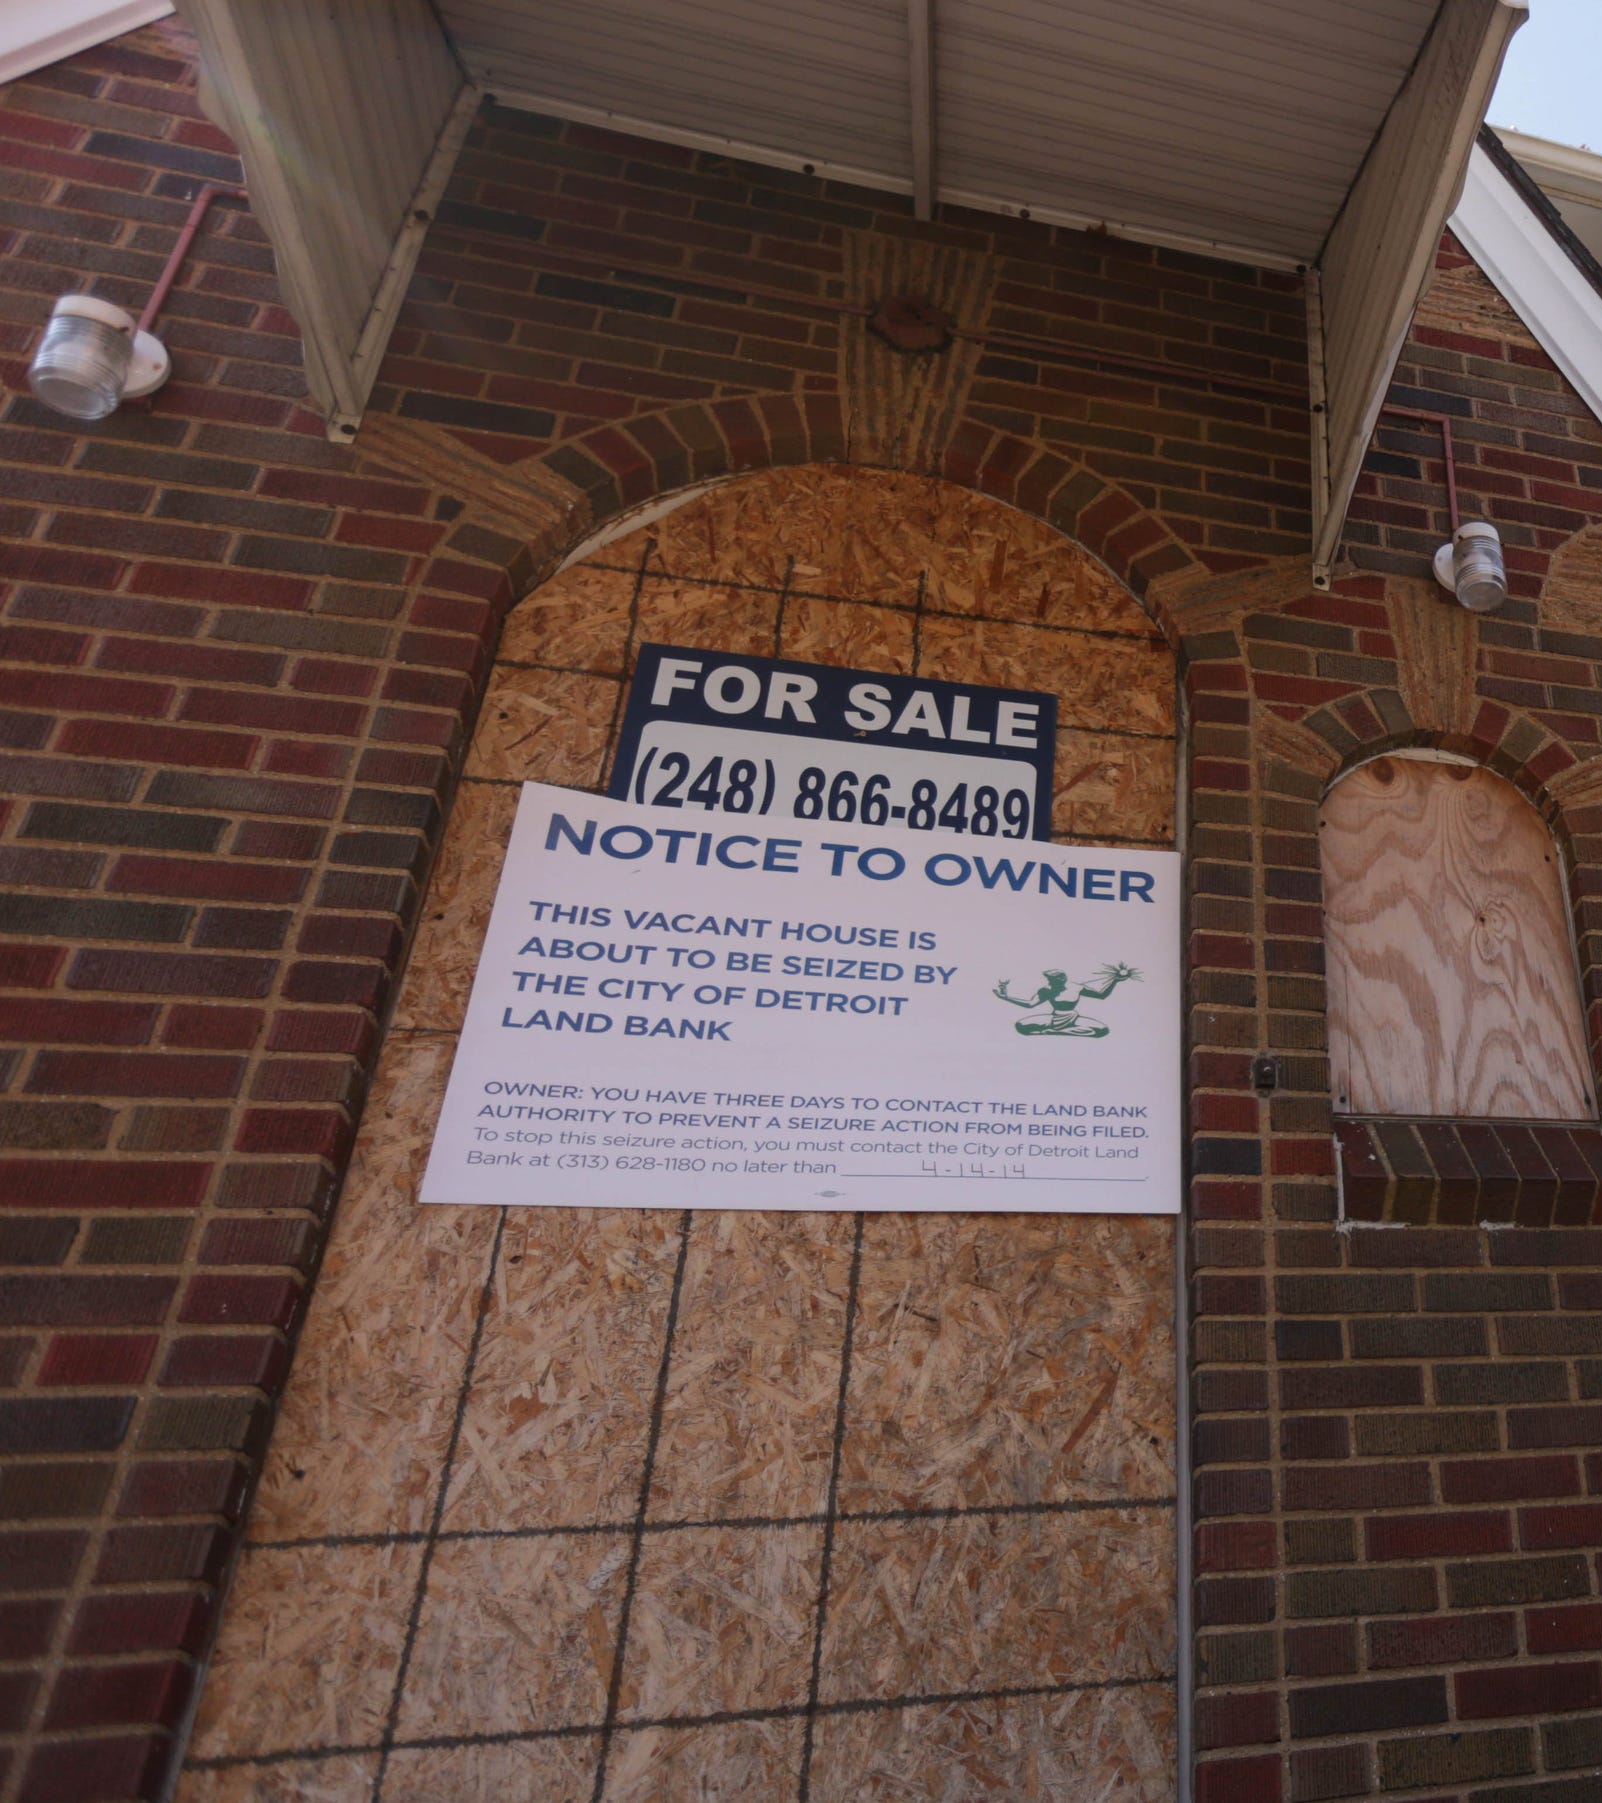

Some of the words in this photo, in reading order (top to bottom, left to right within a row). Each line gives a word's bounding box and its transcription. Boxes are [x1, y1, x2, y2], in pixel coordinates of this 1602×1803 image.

[651, 657, 818, 724] FOR
[844, 683, 1040, 749] SALE
[633, 746, 776, 815] (248)
[793, 766, 1030, 840] 866-8489
[545, 813, 802, 873] NOTICE
[821, 842, 906, 881] TO
[925, 853, 1155, 903] OWNER
[529, 901, 612, 927] THIS
[623, 910, 772, 938] VACANT
[780, 922, 899, 948] HOUSE
[908, 931, 937, 951] IS
[518, 936, 657, 966] ABOUT
[666, 947, 715, 969] TO
[726, 952, 773, 973] BE
[781, 955, 904, 982] SEIZED
[914, 965, 958, 985] BY
[512, 971, 588, 996] THE
[597, 977, 685, 1002] CITY
[693, 984, 746, 1006] OF
[754, 988, 909, 1016] DETROIT
[501, 1007, 613, 1034] LAND
[623, 1015, 734, 1041] BANK
[477, 1104, 617, 1124] AUTHORITY
[621, 1111, 652, 1125] TO
[658, 1113, 761, 1129] PREVENT
[765, 1116, 782, 1129] A
[788, 1117, 875, 1131] SEIZURE
[881, 1119, 959, 1134] ACTION
[965, 1122, 1022, 1136] FROM
[1028, 1123, 1087, 1137] BEING
[1092, 1125, 1150, 1139] FILED.
[483, 1081, 583, 1099] OWNER:
[591, 1087, 640, 1101] YOU
[645, 1089, 707, 1105] HAVE
[713, 1092, 784, 1108] THREE
[791, 1096, 845, 1110] DAYS
[851, 1097, 880, 1111] TO
[885, 1099, 983, 1114] CONTACT
[988, 1102, 1027, 1115] THE
[1032, 1104, 1088, 1117] LAND
[1093, 1105, 1147, 1118] BANK
[466, 1150, 524, 1166] Bank
[528, 1153, 551, 1167] at
[557, 1153, 610, 1170] (313)
[615, 1156, 706, 1173] 628-1180
[711, 1160, 739, 1174] no
[743, 1159, 787, 1174] later
[793, 1160, 837, 1175] than
[473, 1127, 498, 1142] To
[504, 1130, 553, 1146] stop
[559, 1131, 597, 1146] this
[602, 1133, 676, 1149] seizure
[681, 1135, 748, 1152] action,
[753, 1139, 788, 1153] you
[796, 1139, 844, 1153] must
[850, 1140, 923, 1155] contact
[928, 1141, 959, 1156] the
[963, 1142, 1000, 1159] City
[1004, 1143, 1024, 1157] of
[1028, 1144, 1090, 1158] Detroit
[1095, 1146, 1139, 1159] Land
